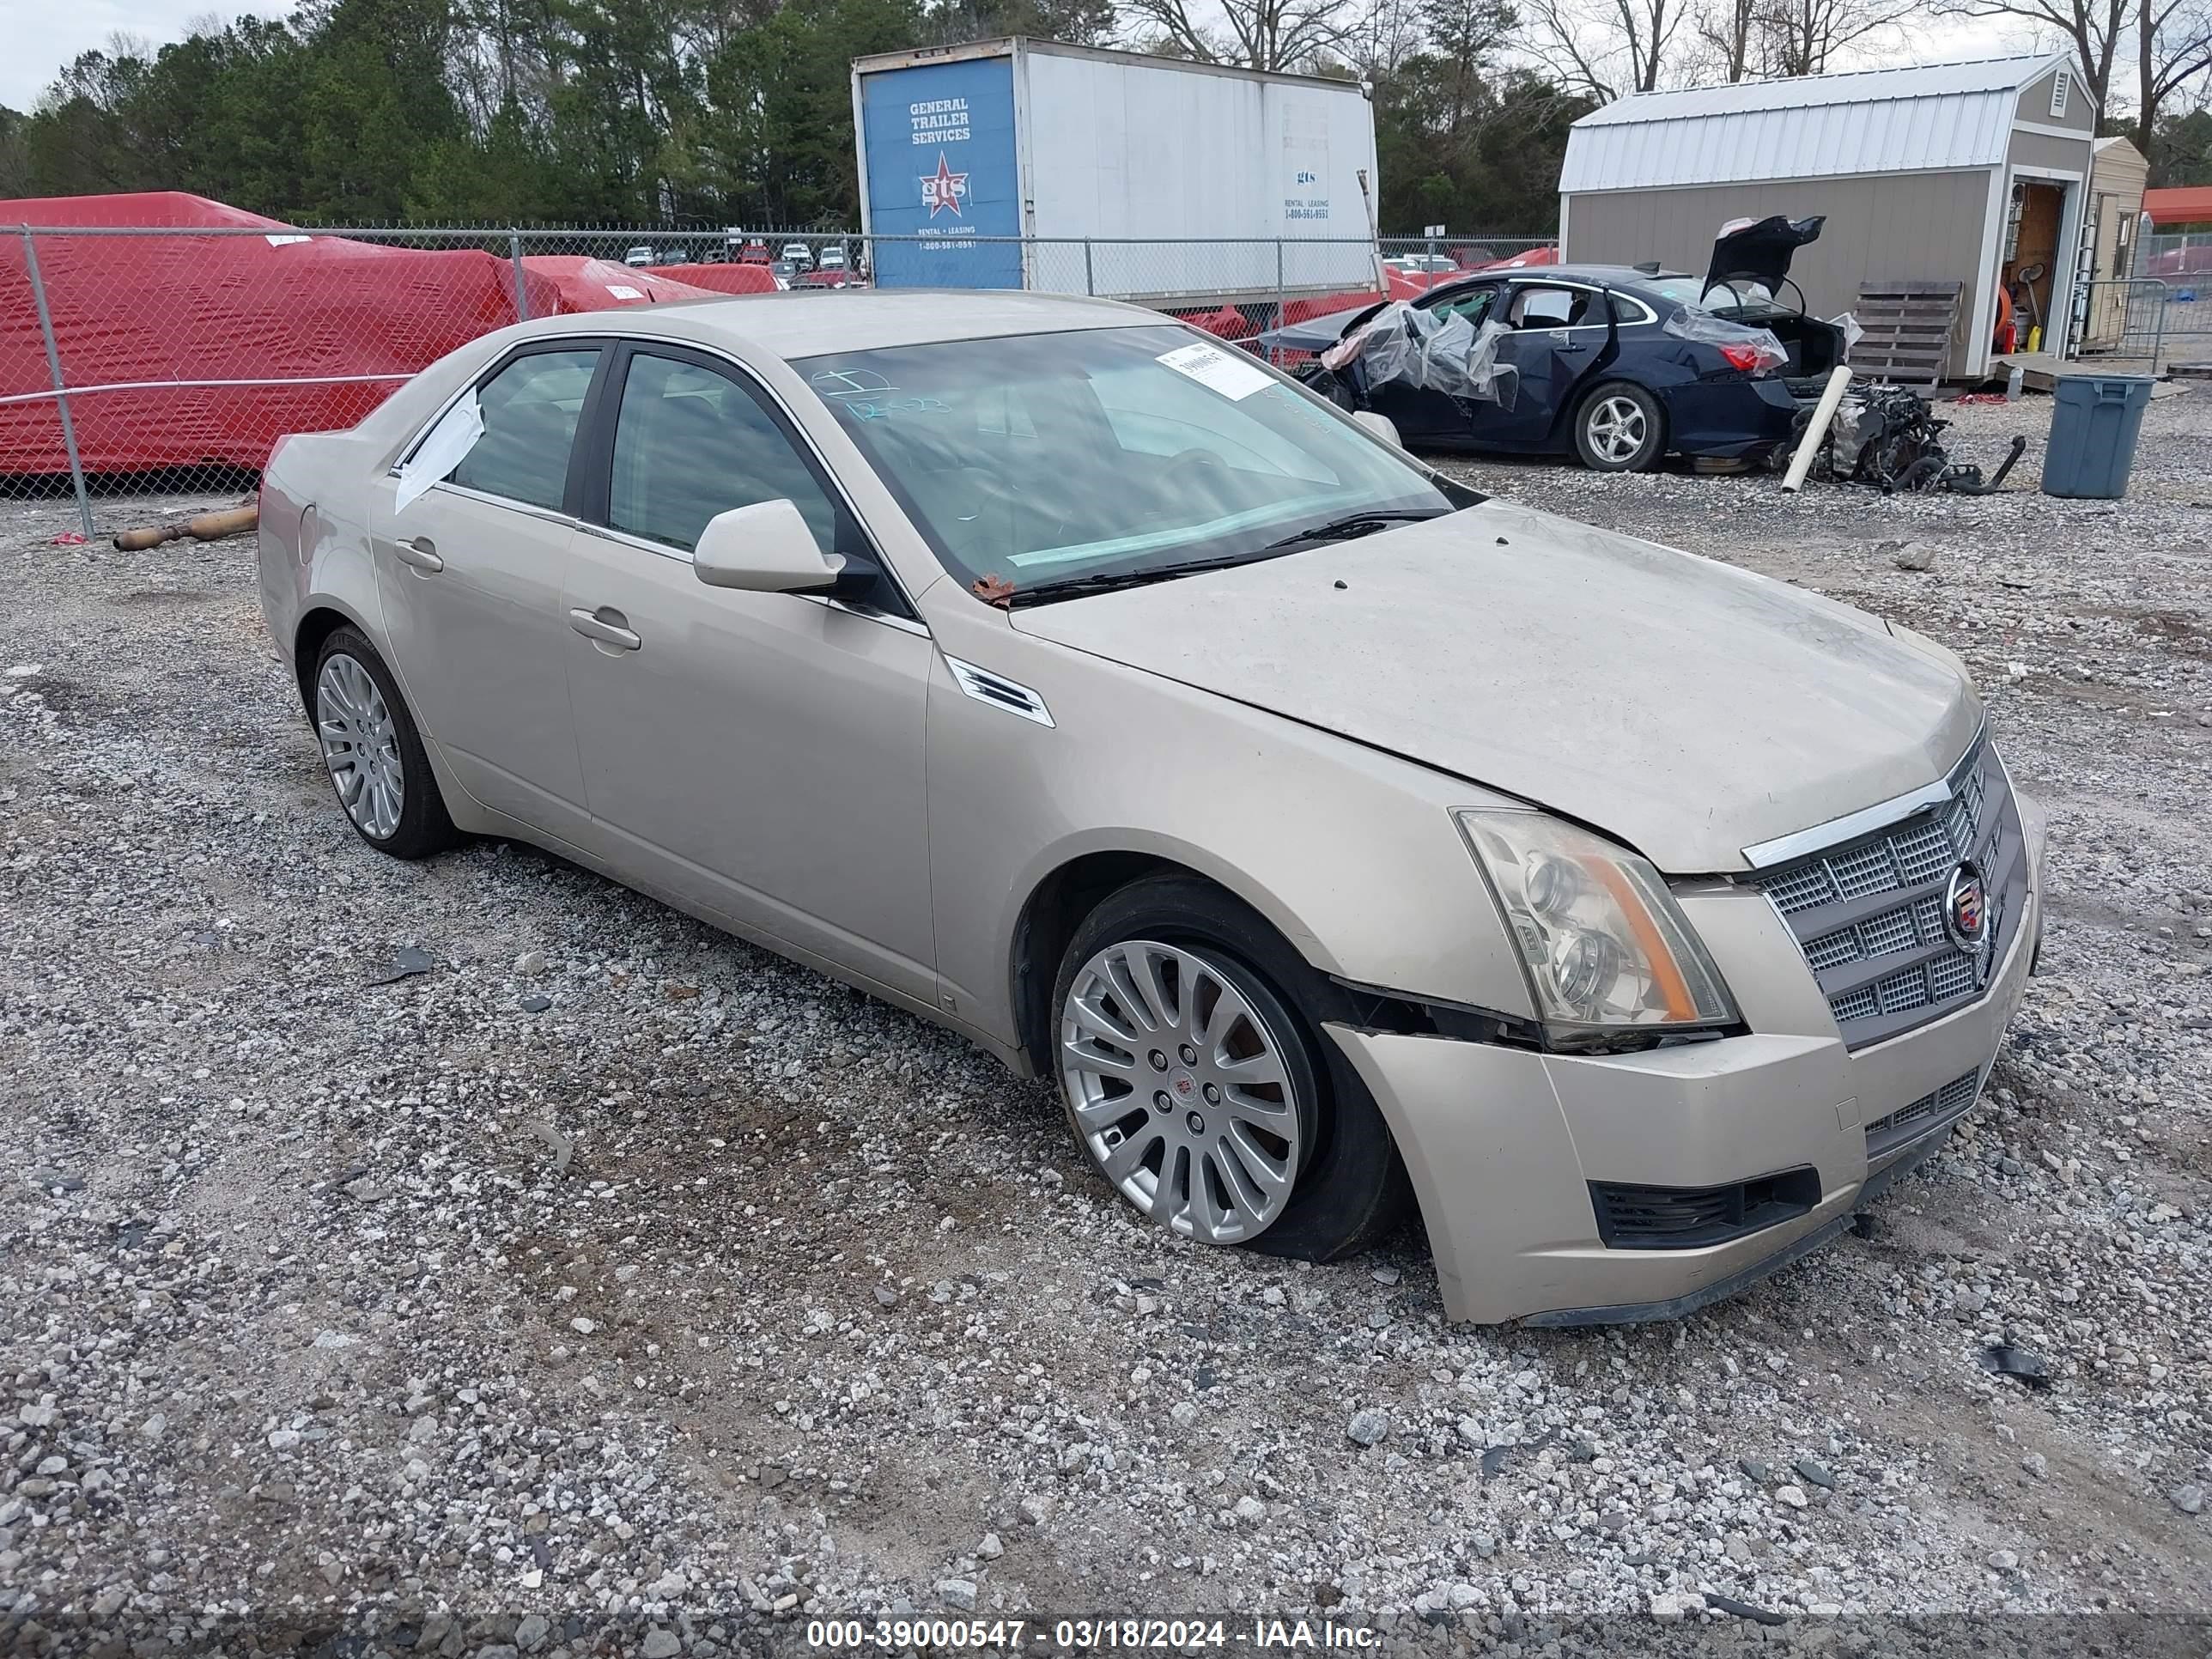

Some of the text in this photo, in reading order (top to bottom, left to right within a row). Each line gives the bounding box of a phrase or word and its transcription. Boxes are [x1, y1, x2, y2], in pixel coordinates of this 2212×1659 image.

[910, 98, 969, 115] GENERAL
[911, 112, 969, 130] TRAILER
[912, 128, 970, 145] SERVICES
[1297, 171, 1316, 185] gts
[921, 176, 966, 206] gts
[948, 226, 975, 234] LEASING
